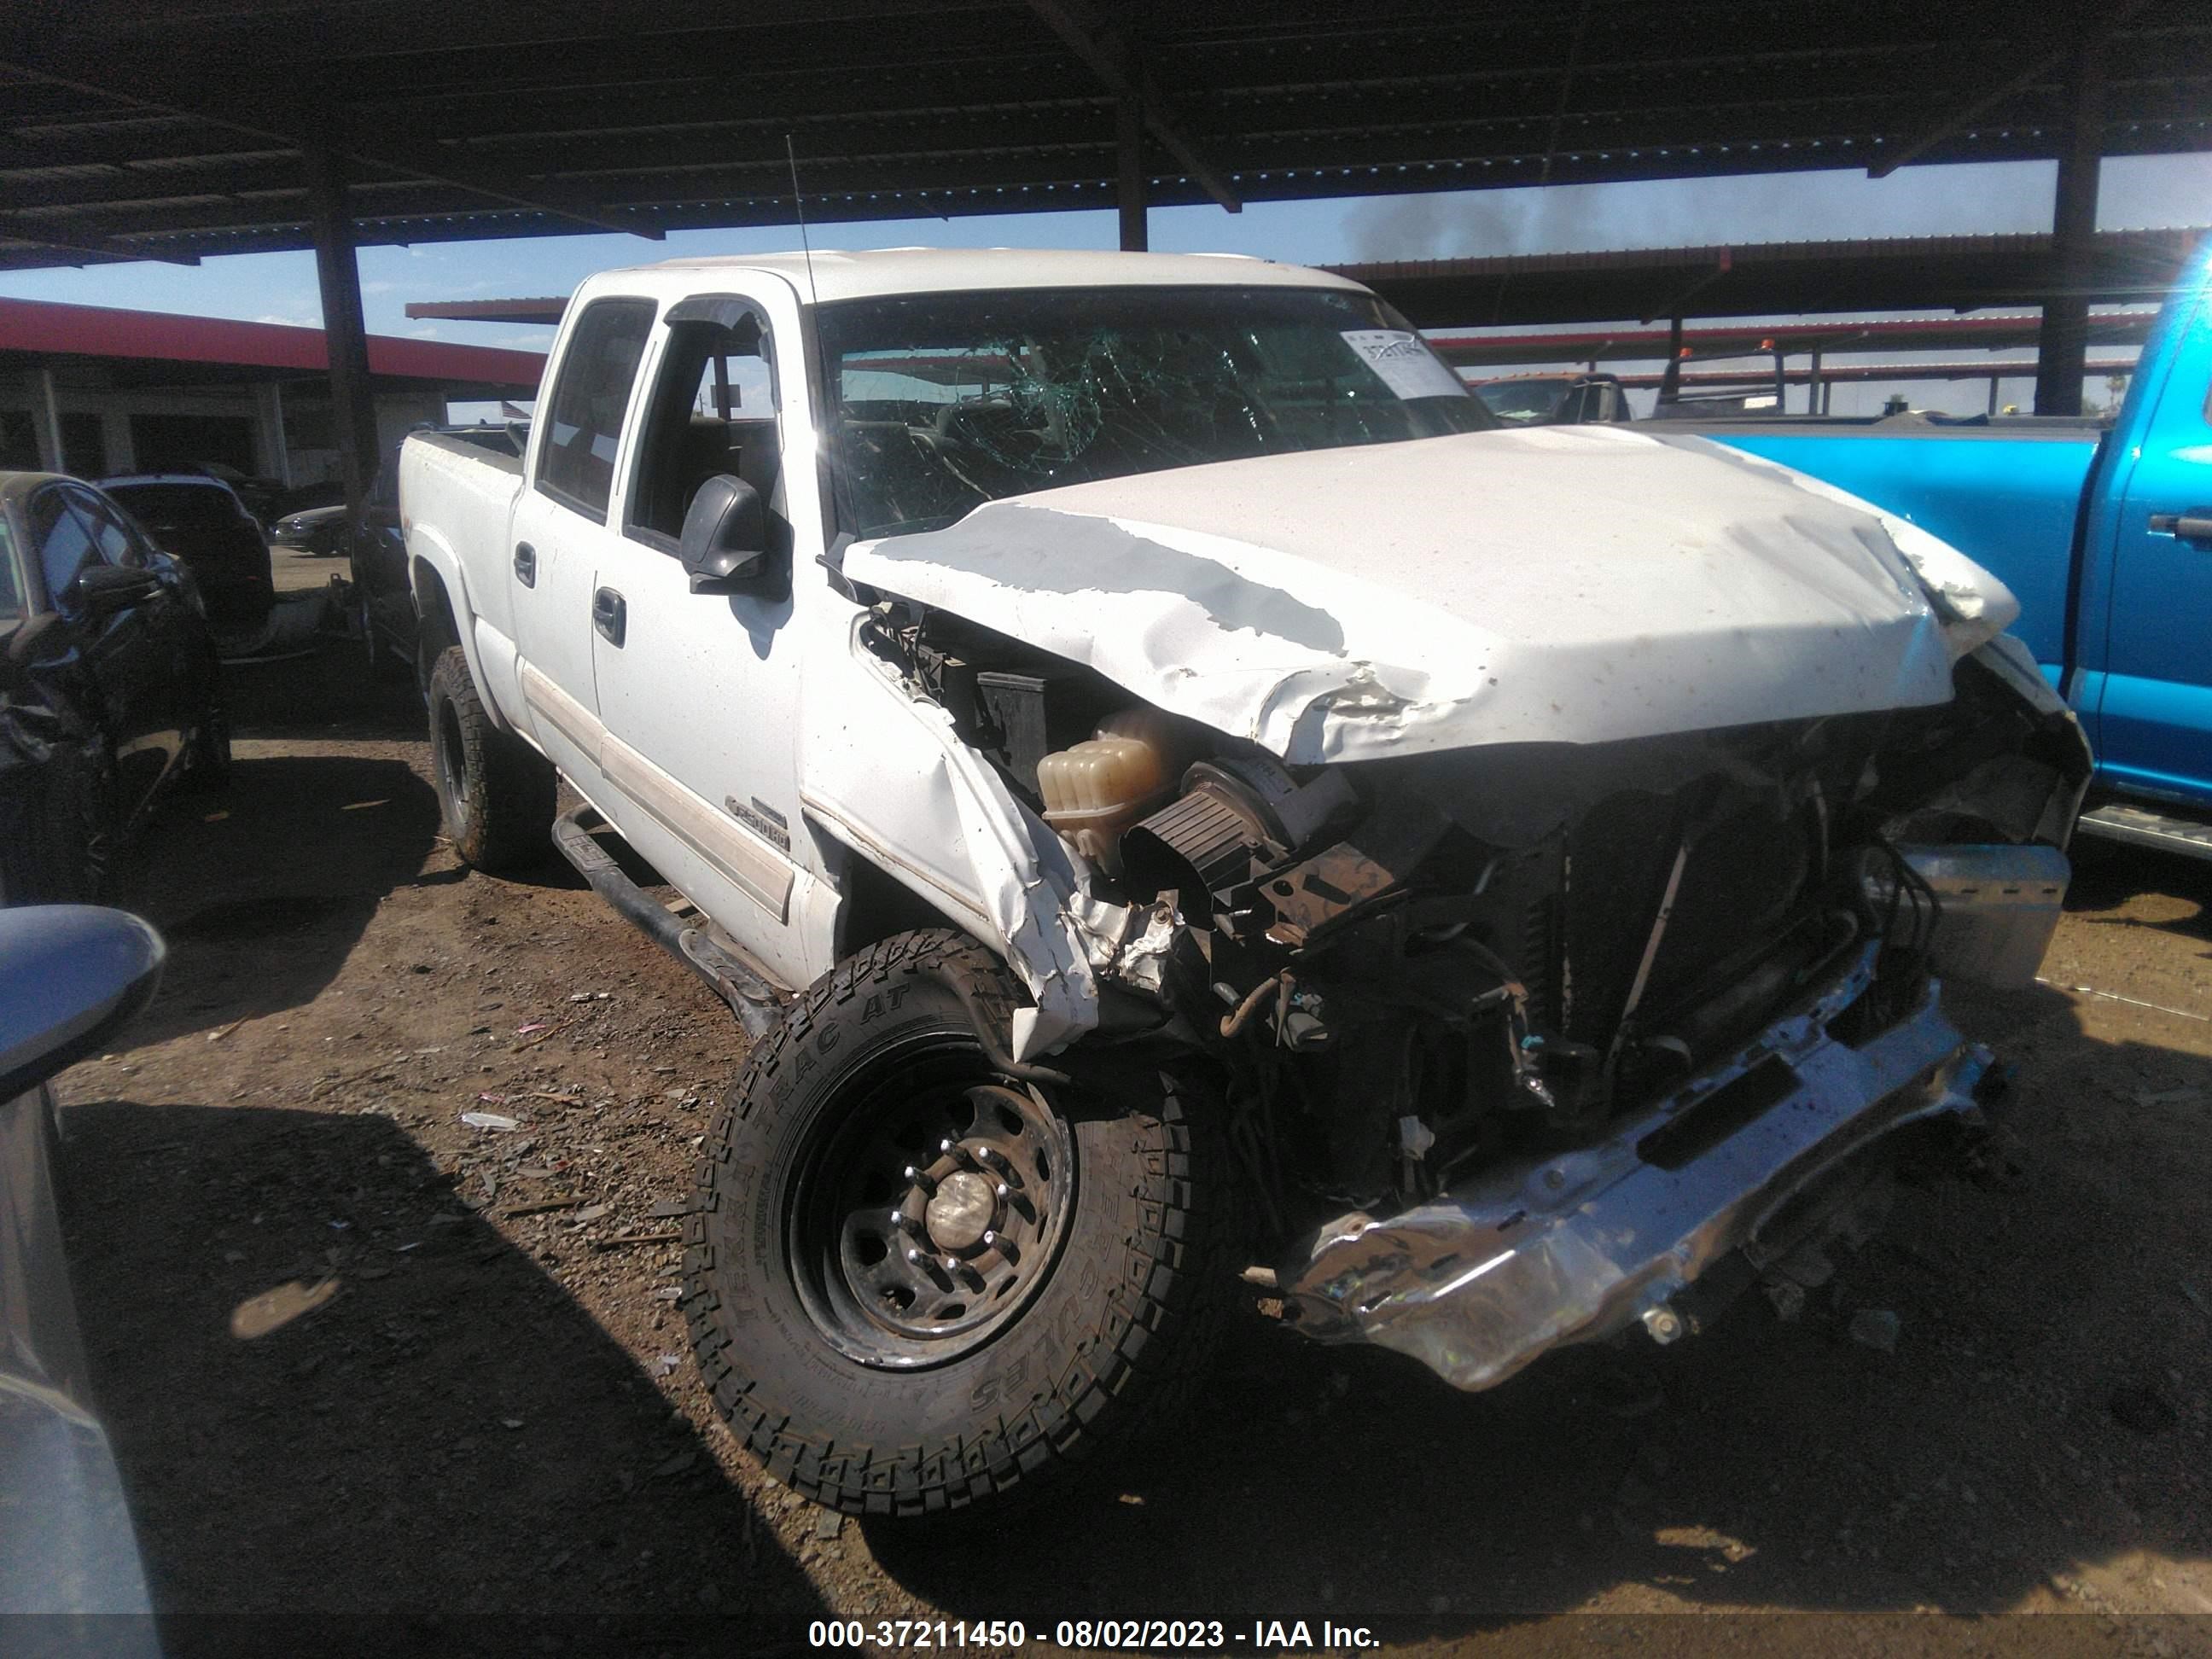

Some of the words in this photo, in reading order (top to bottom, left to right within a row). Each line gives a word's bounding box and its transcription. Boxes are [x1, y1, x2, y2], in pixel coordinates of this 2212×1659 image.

[752, 1021, 841, 1134] TRAC
[862, 983, 910, 1023] AT
[969, 1152, 1125, 1413] HERCULES
